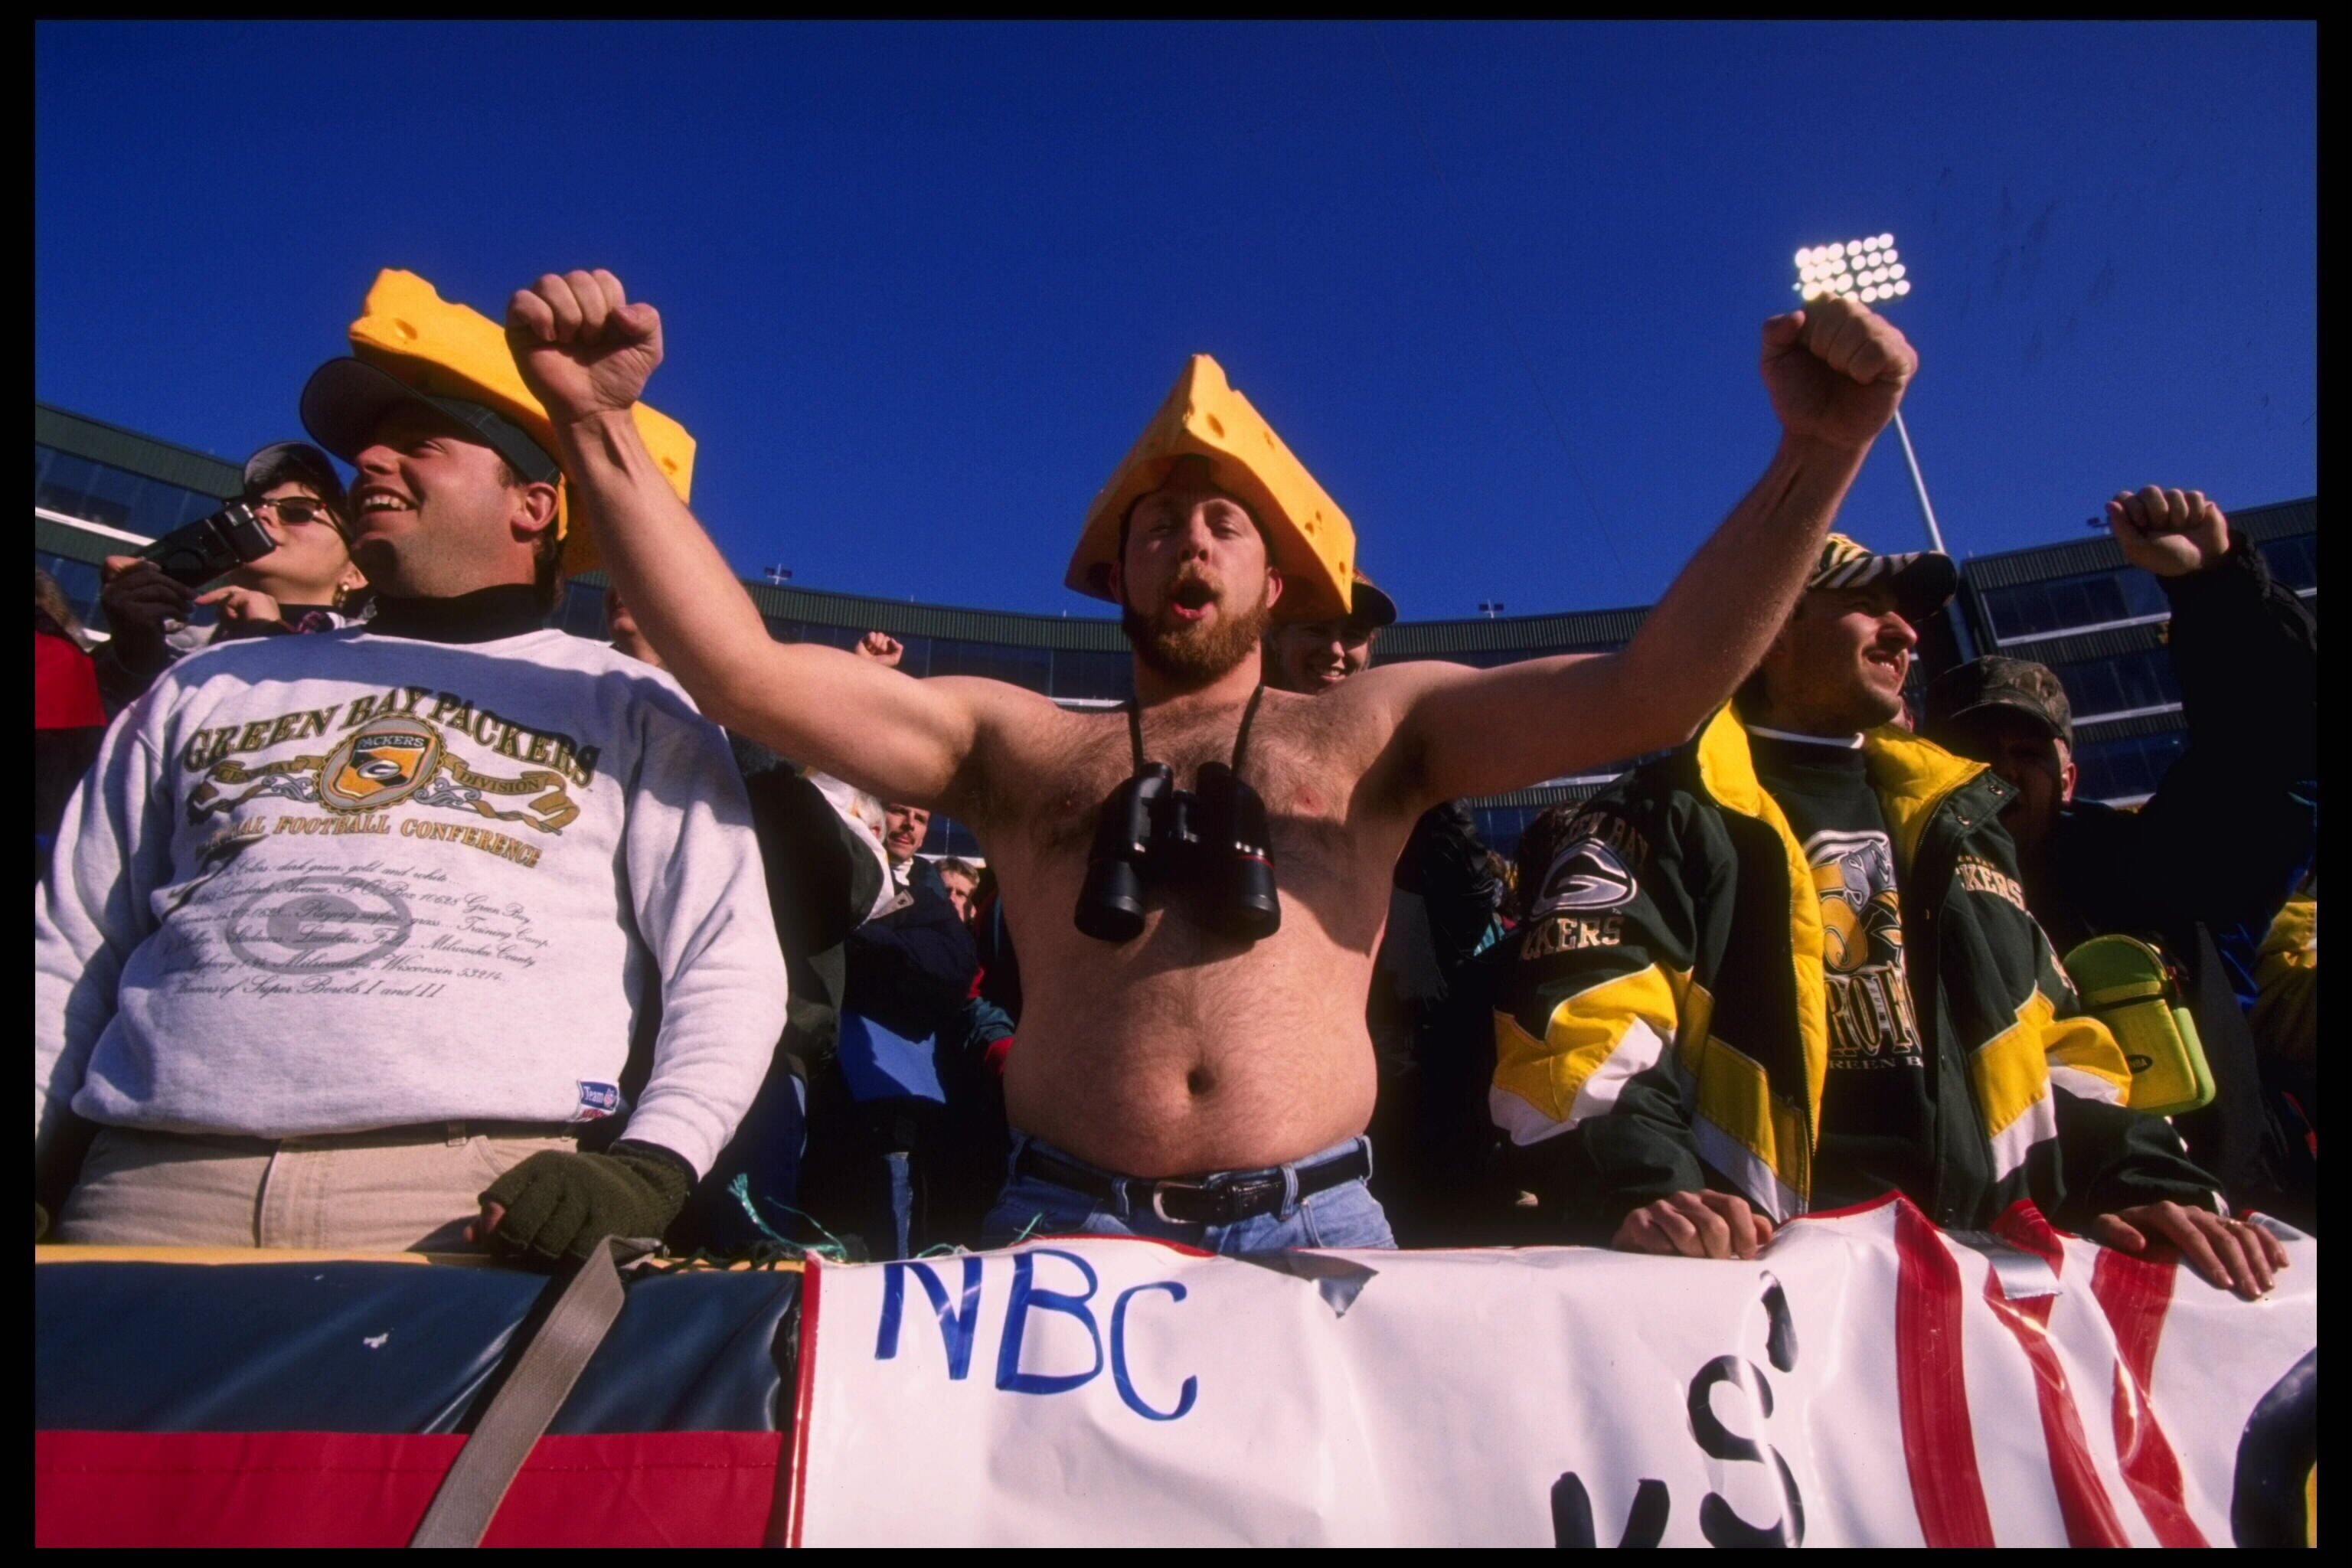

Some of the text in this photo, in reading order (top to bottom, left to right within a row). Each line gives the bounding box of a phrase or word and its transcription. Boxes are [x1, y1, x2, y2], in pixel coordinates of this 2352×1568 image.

[184, 686, 602, 789] GREEN BAY PACKERS
[459, 772, 540, 792] DIVISION
[273, 814, 391, 835] FOOTBALL
[400, 818, 543, 869] CONFERENCE
[381, 865, 416, 877] and
[381, 880, 416, 900] Box
[462, 893, 500, 914] Green
[1955, 863, 2026, 912] KERS
[456, 916, 512, 940] Training
[381, 953, 452, 976] Wisconsin
[496, 942, 536, 969] County
[242, 974, 292, 999] Super
[296, 973, 368, 995] Bowls
[381, 982, 416, 997] and
[1828, 1055, 1924, 1070] REEN B
[874, 1249, 1199, 1422] NBC
